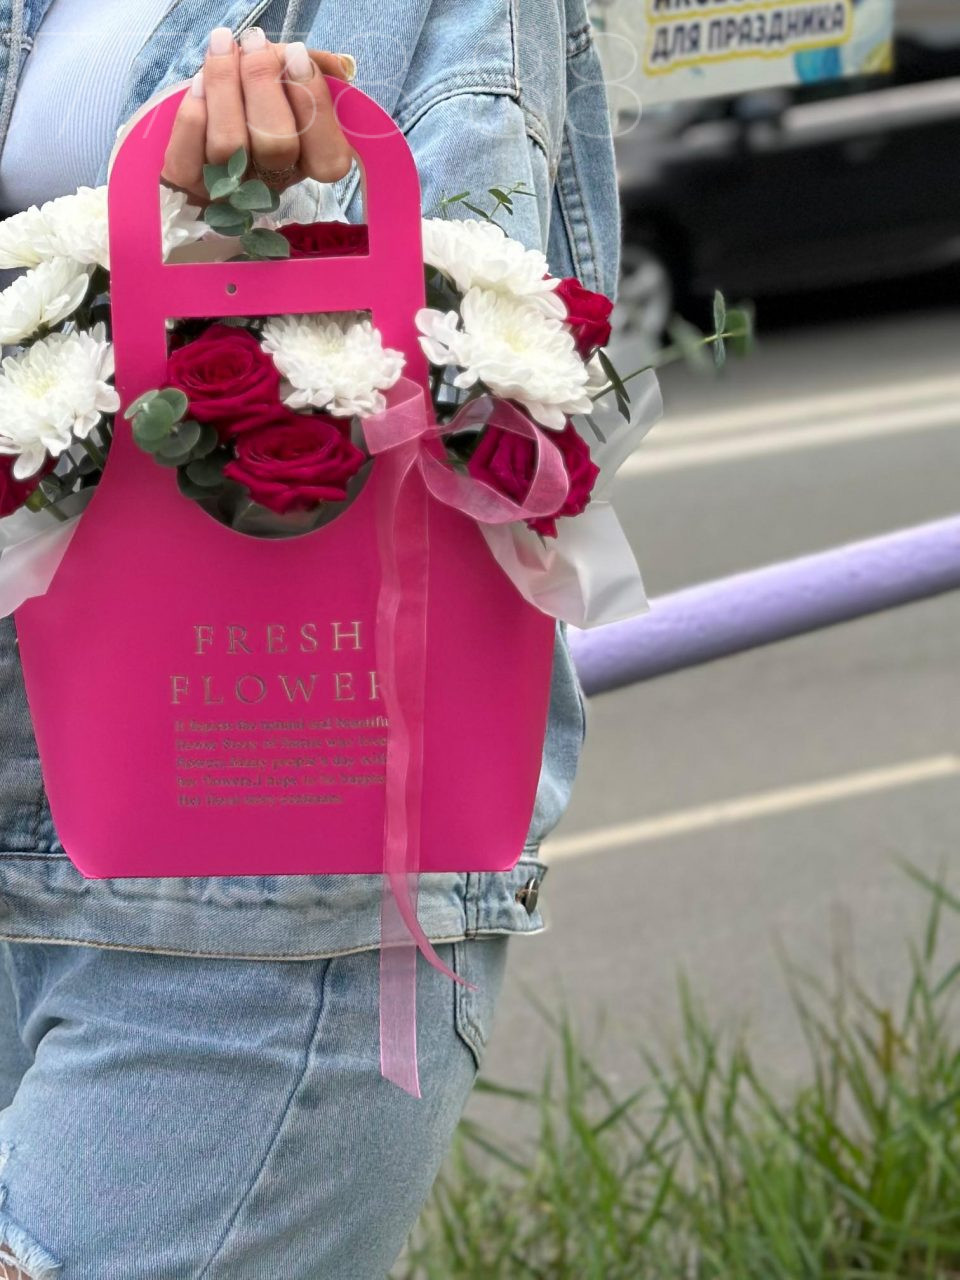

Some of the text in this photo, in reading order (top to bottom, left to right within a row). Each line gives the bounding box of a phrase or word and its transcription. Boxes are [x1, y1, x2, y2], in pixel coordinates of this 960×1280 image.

[650, 3, 845, 63] ДЛЯ ПРАЗДНИКА
[193, 621, 364, 655] FRESH
